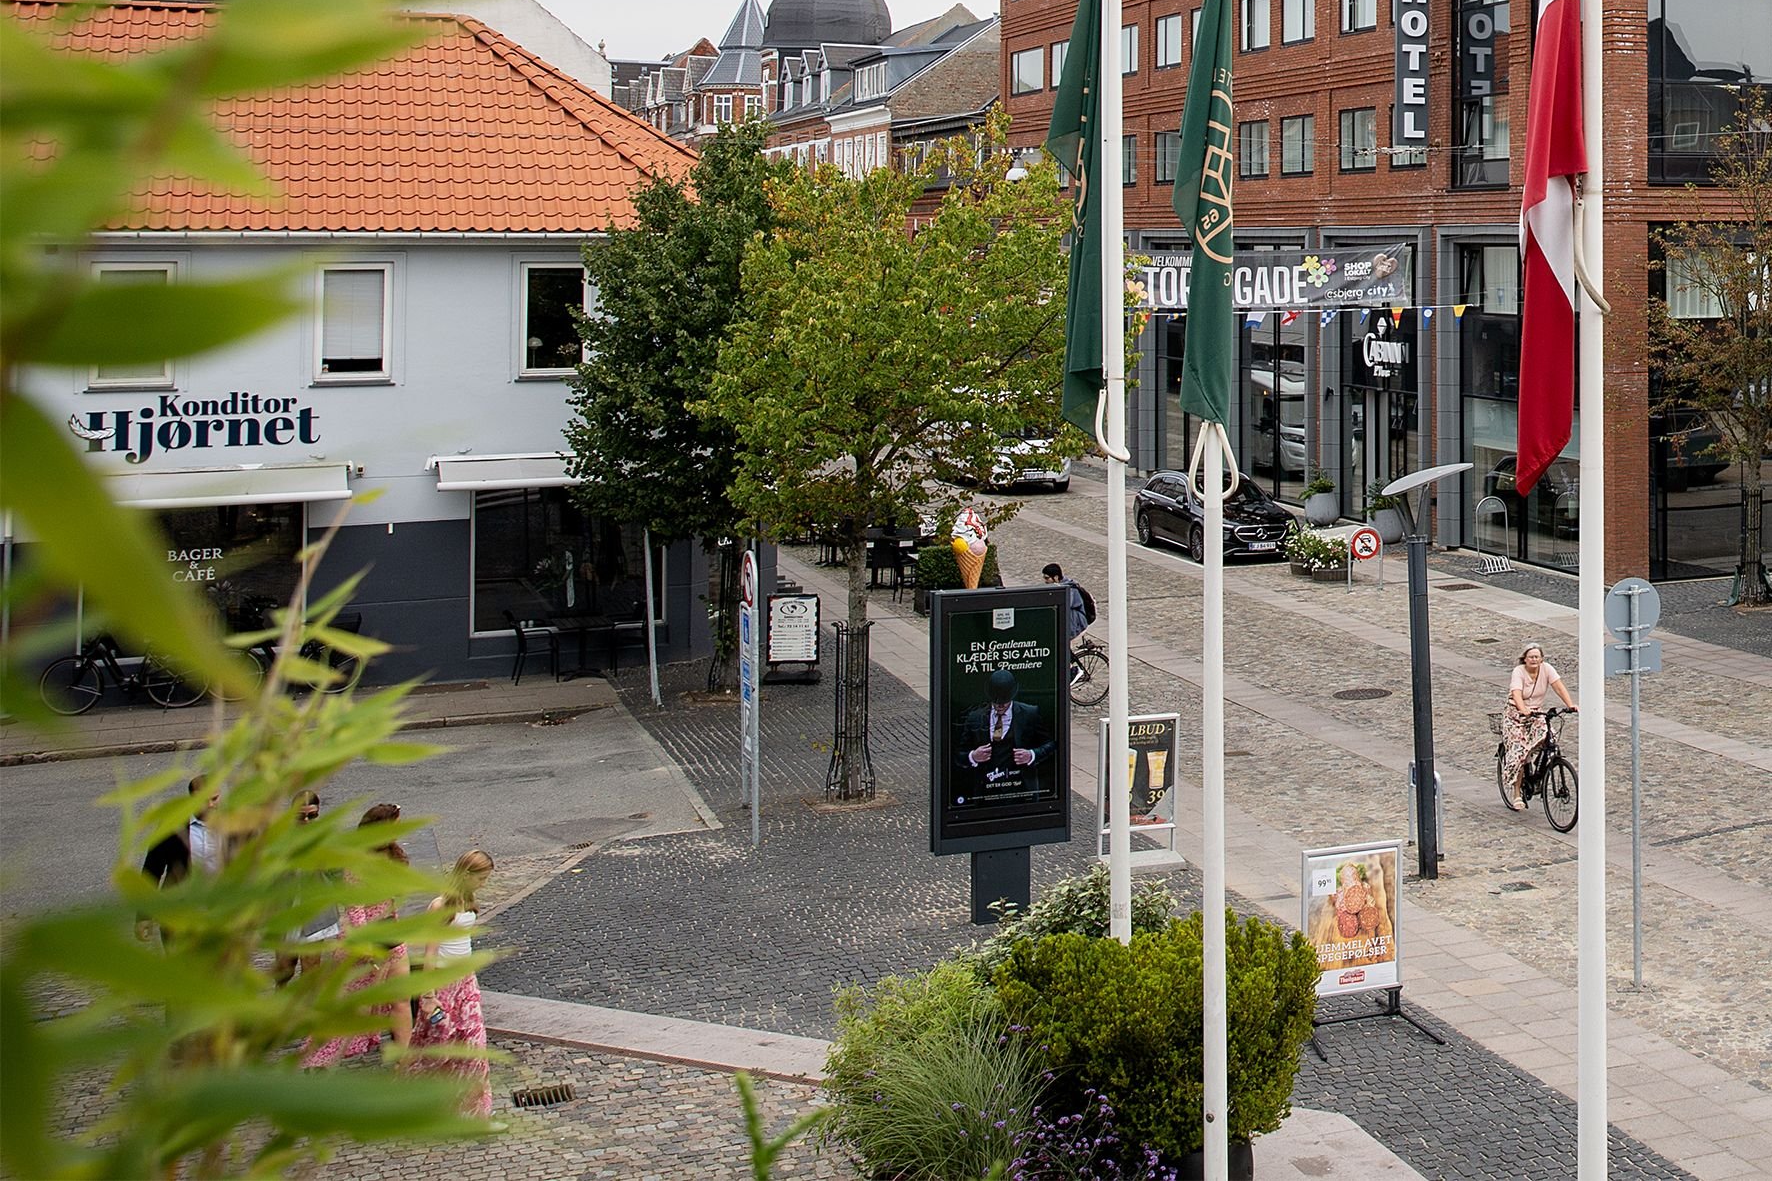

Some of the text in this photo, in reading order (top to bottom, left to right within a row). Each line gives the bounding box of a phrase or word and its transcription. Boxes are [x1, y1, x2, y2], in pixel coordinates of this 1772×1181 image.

[1344, 262, 1372, 271] SHOP
[1344, 269, 1372, 277] LOKALT
[1367, 286, 1389, 297] city
[158, 392, 297, 417] Konditor
[85, 407, 321, 464] Hjørnet
[167, 548, 223, 562] BAGER
[190, 561, 199, 570] &
[172, 566, 216, 582] CAFÉ
[970, 639, 1037, 653] EN Gentleman
[956, 647, 1051, 664] KLÆDER SIG ALTID
[965, 660, 1043, 674] PÅ TIL Premiere
[1128, 723, 1165, 737] LBUD
